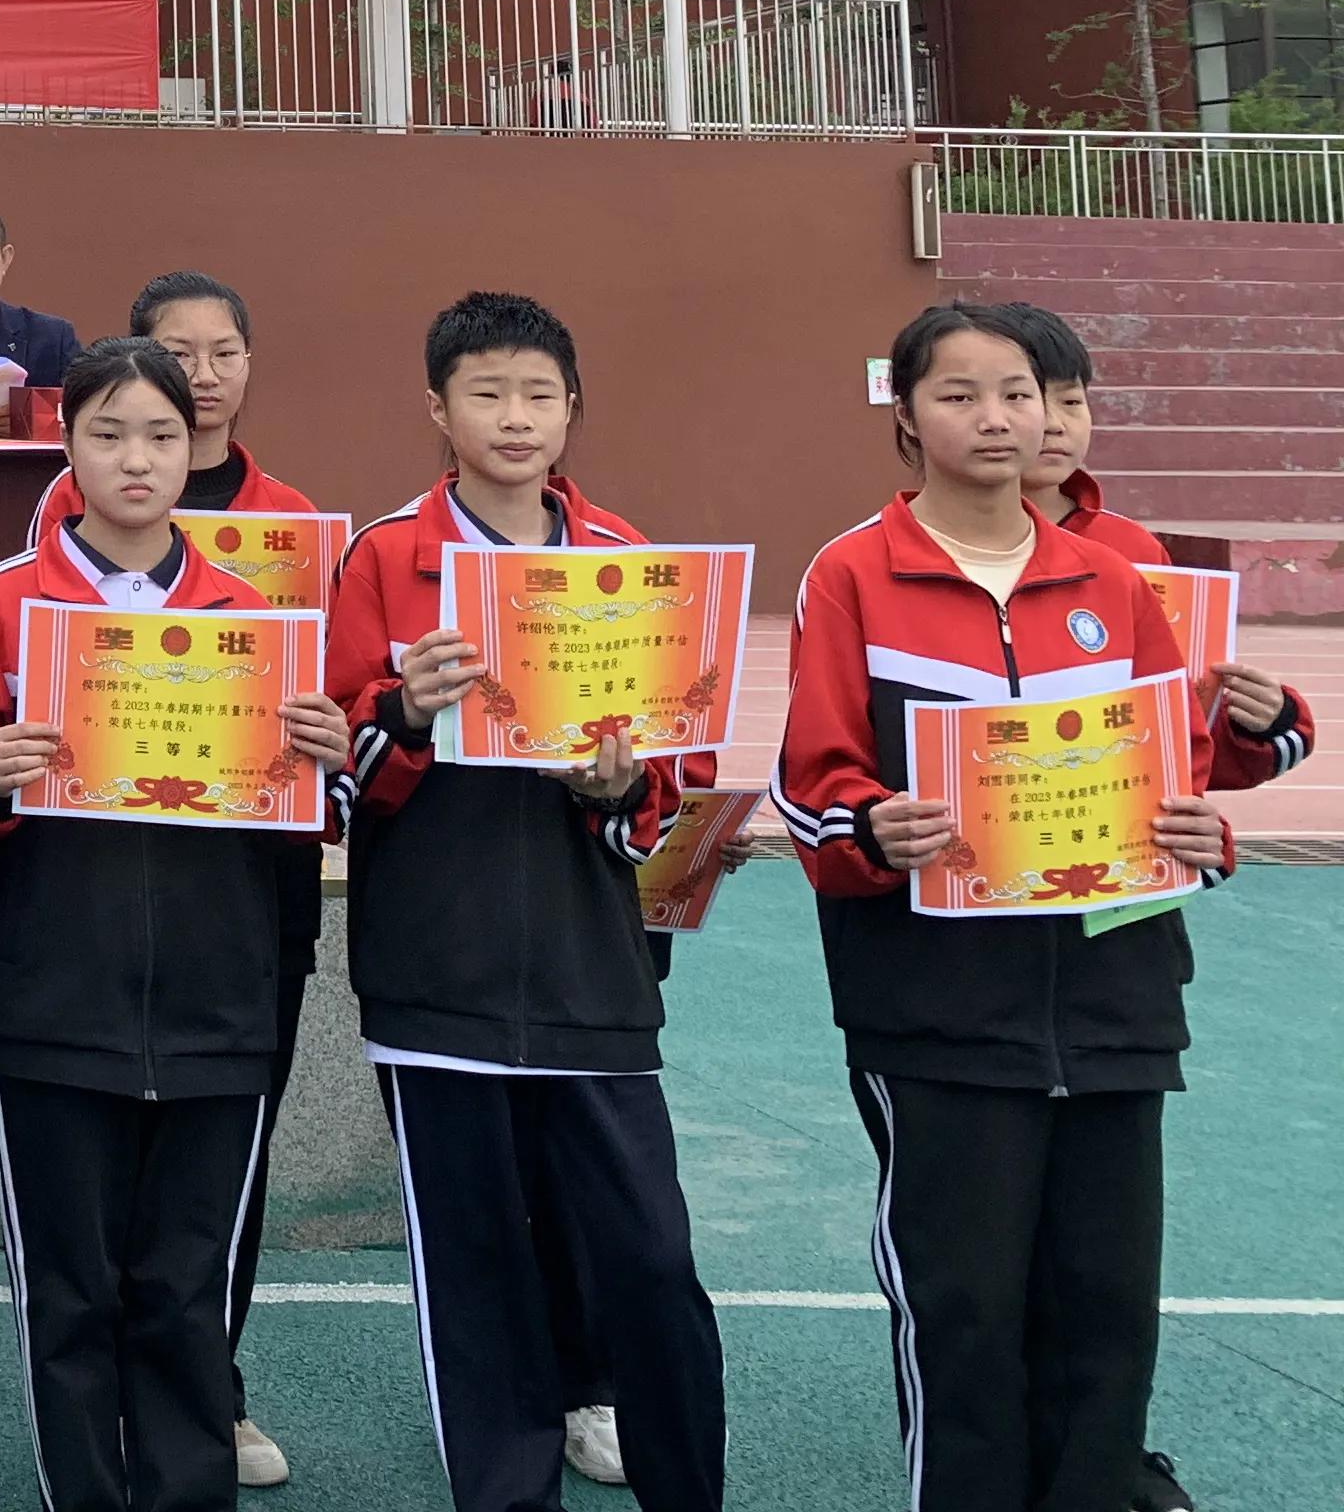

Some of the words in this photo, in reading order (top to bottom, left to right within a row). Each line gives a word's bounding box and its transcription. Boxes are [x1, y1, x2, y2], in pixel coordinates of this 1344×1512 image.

[579, 676, 636, 698] 三等奖
[135, 740, 212, 759] 三等奖
[1039, 823, 1110, 846] 三等奖
